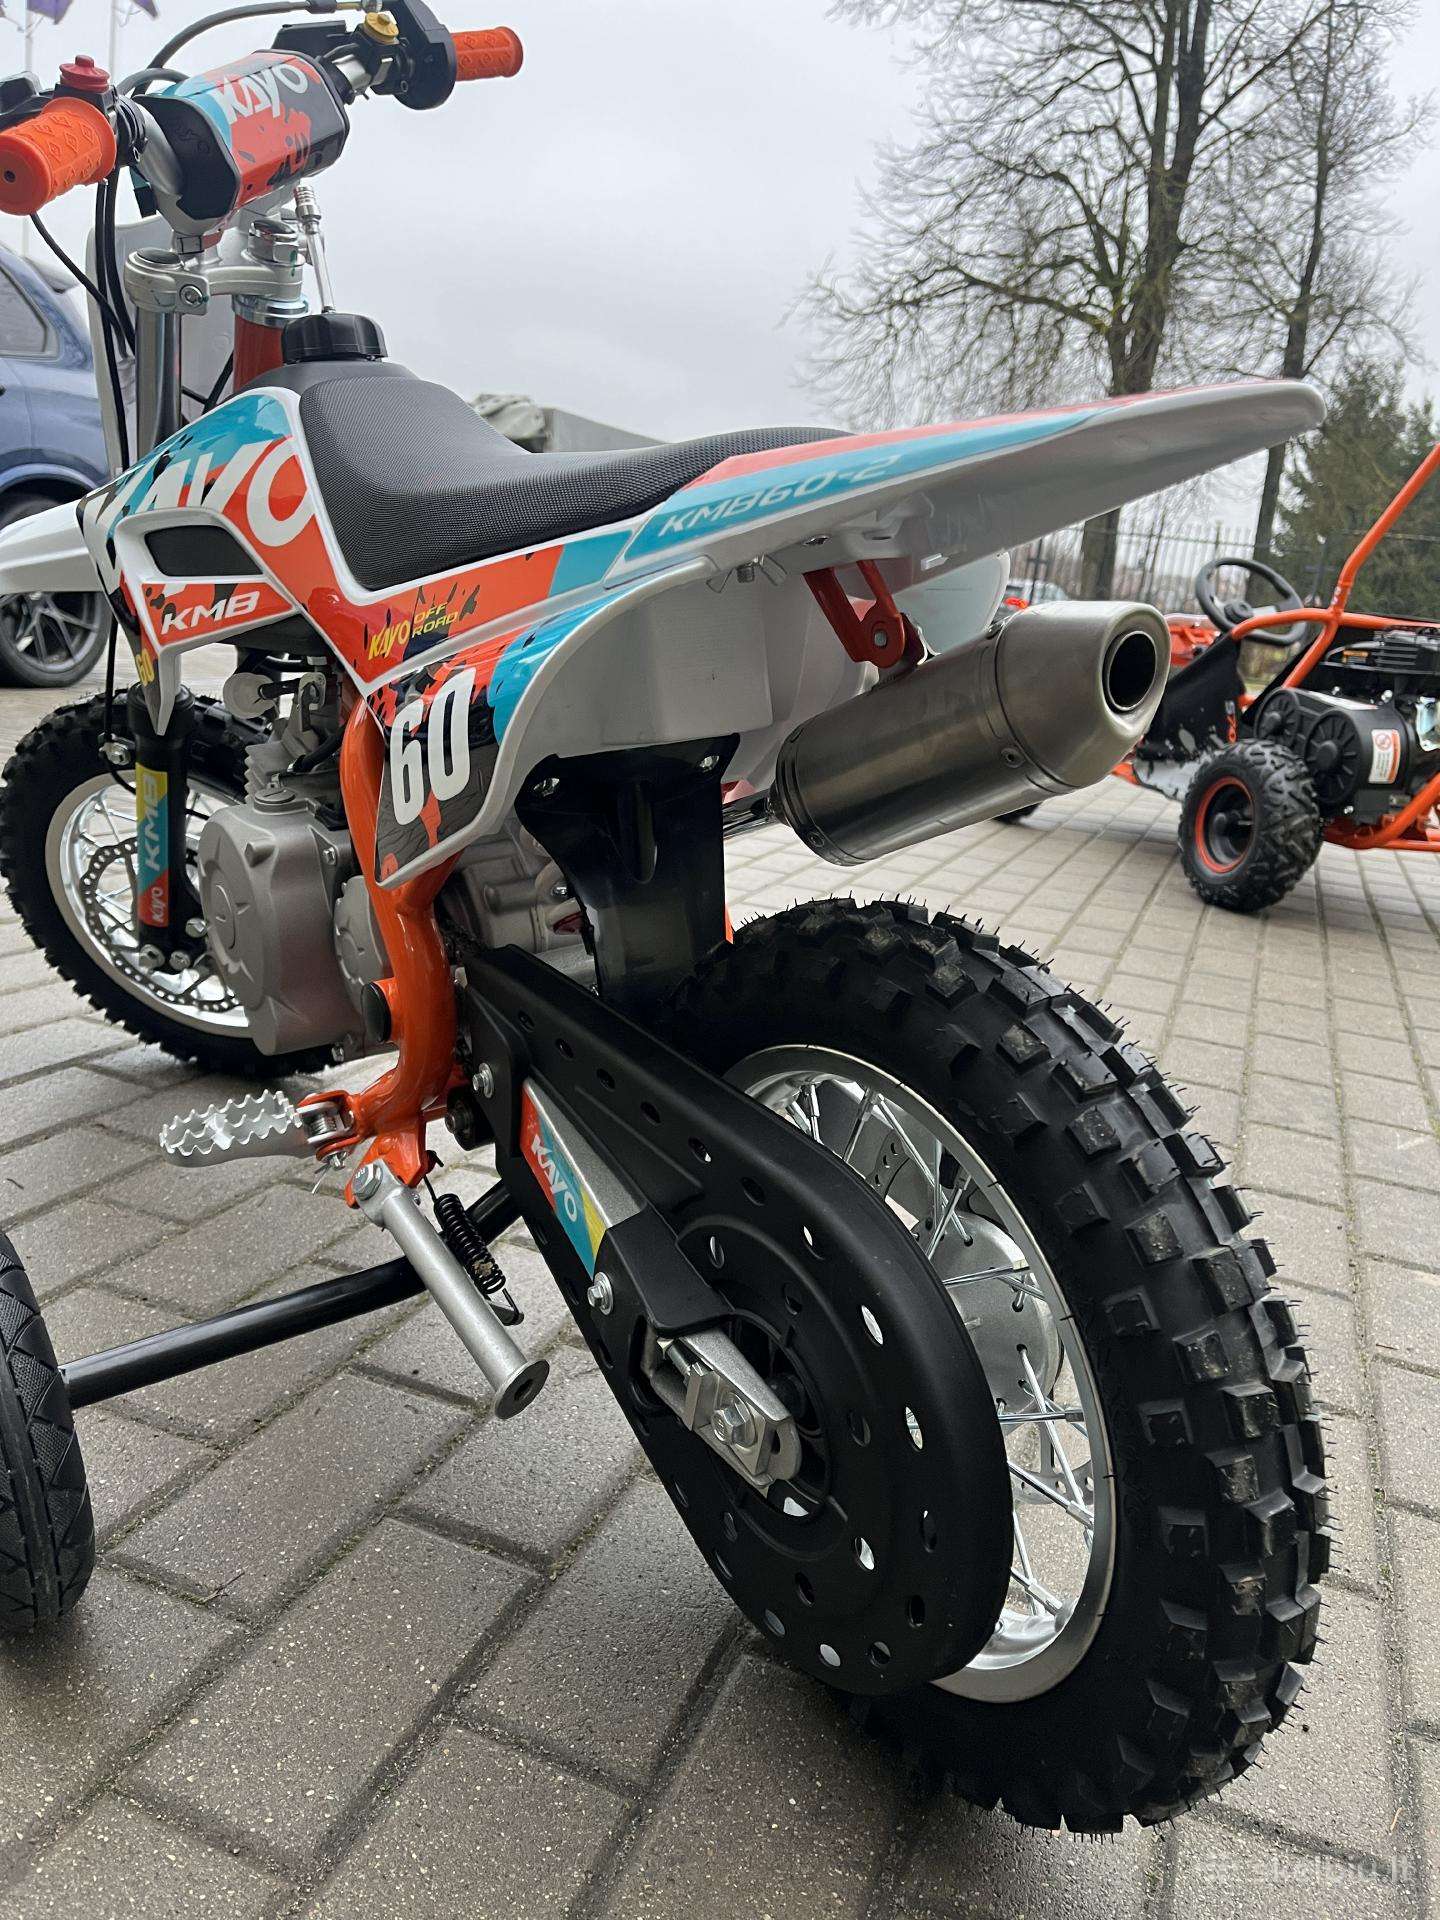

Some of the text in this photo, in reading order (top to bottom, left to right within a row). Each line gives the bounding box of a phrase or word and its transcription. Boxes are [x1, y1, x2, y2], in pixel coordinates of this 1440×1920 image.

[213, 63, 309, 124] KAYO
[658, 455, 900, 538] KMB60-2
[160, 590, 260, 636] KMB
[412, 612, 459, 638] ROAD
[413, 601, 448, 624] OFF
[135, 648, 155, 686] 60
[389, 666, 477, 826] 60
[142, 773, 161, 872] KMB
[530, 1133, 578, 1222] KAYO
